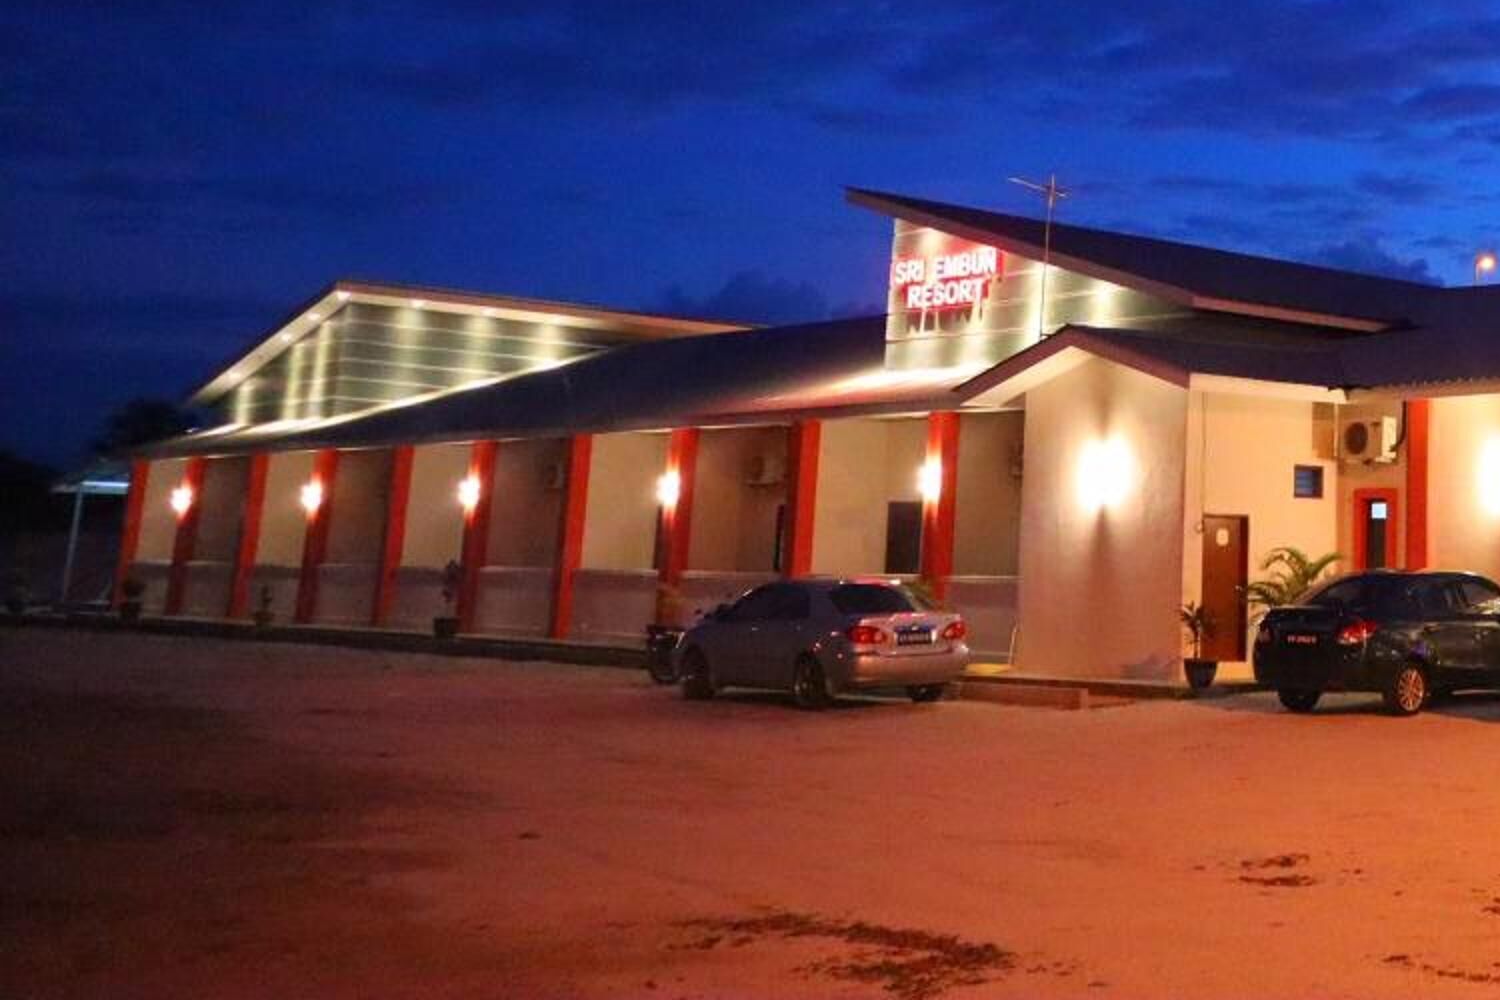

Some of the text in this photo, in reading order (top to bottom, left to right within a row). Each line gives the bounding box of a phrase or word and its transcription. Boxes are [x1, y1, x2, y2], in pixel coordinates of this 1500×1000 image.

[895, 247, 997, 284] SRI EMBUN
[906, 278, 984, 309] RESORT
